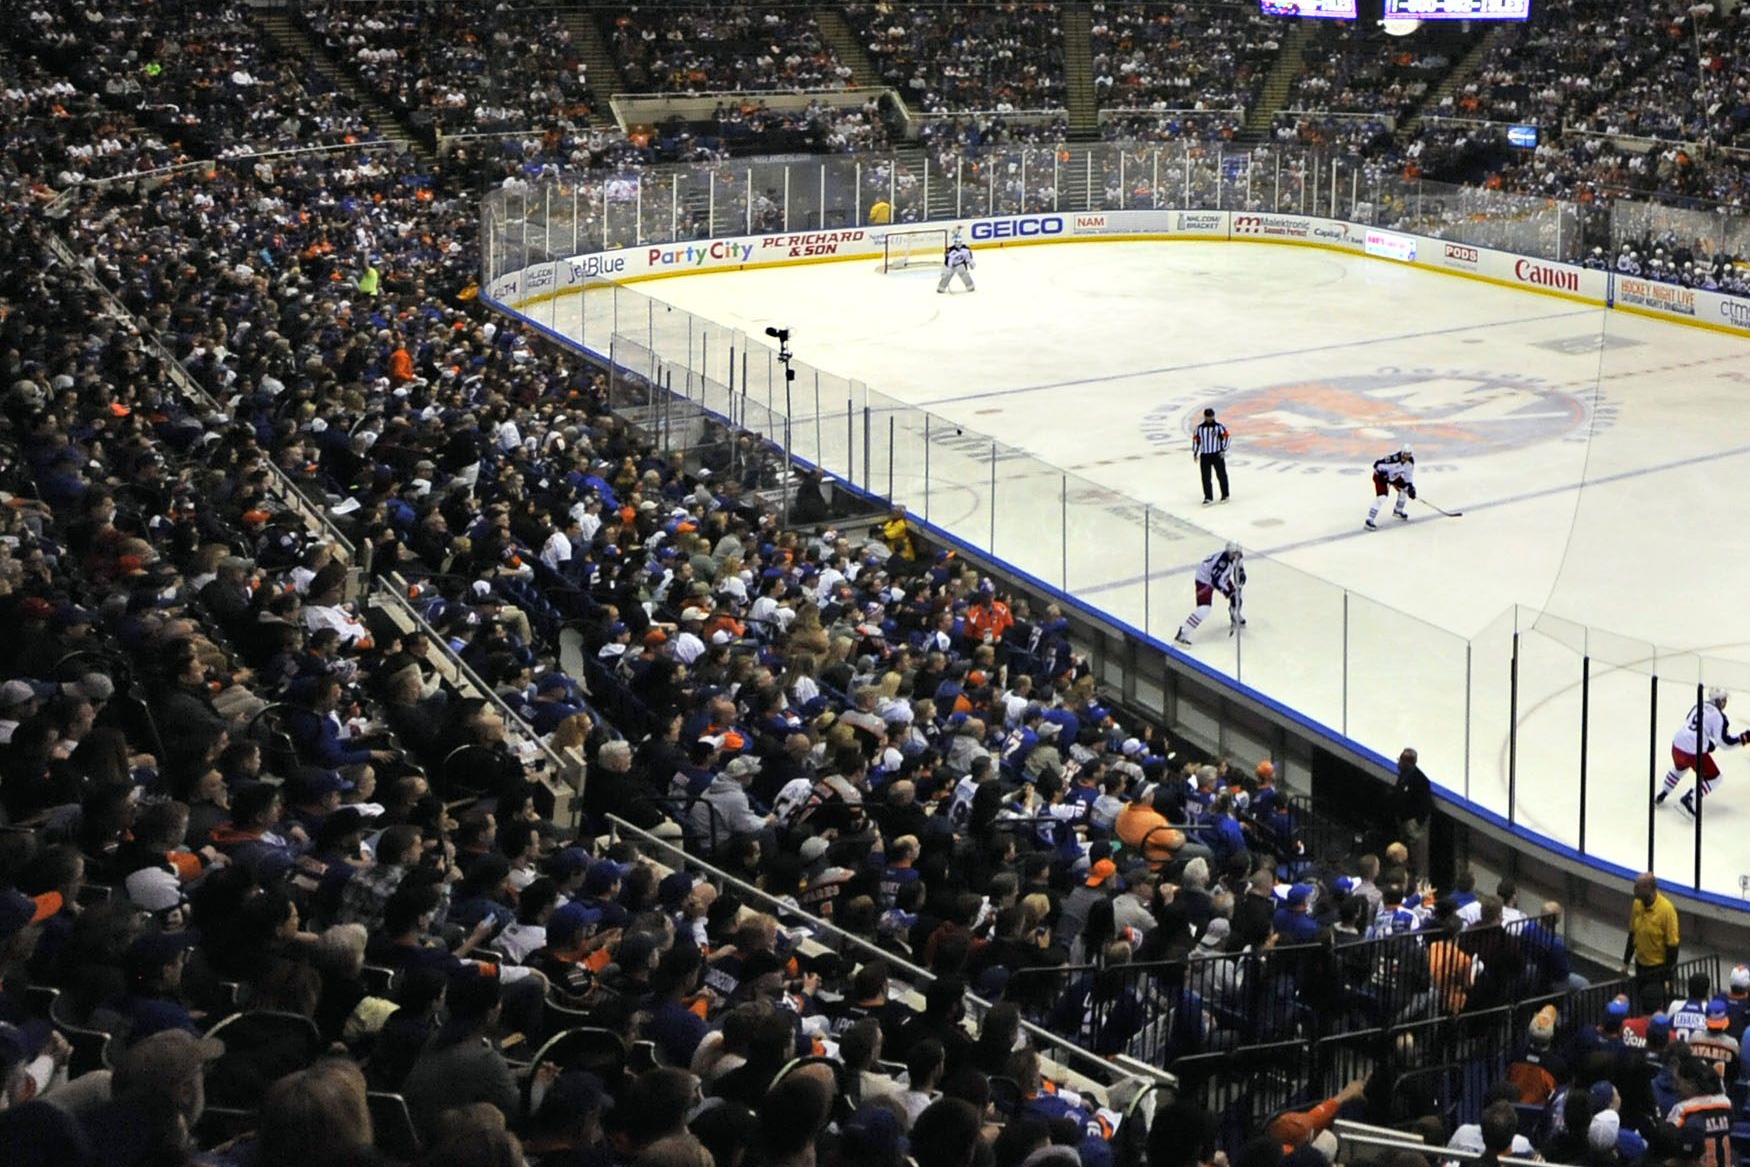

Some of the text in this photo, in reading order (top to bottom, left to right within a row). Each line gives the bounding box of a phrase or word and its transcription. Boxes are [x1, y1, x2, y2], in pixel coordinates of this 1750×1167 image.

[971, 217, 1064, 240] GEICO
[1077, 217, 1105, 227] NAM
[788, 231, 864, 247] RICHARD
[789, 244, 838, 257] & SON
[649, 241, 753, 266] Party City
[1446, 246, 1478, 262] PODS
[568, 256, 626, 284] jetBlue
[1515, 258, 1580, 291] Canon
[1621, 279, 1651, 297] HOCKEY
[1652, 286, 1676, 303] NIGHT
[1677, 290, 1696, 306] LIVE
